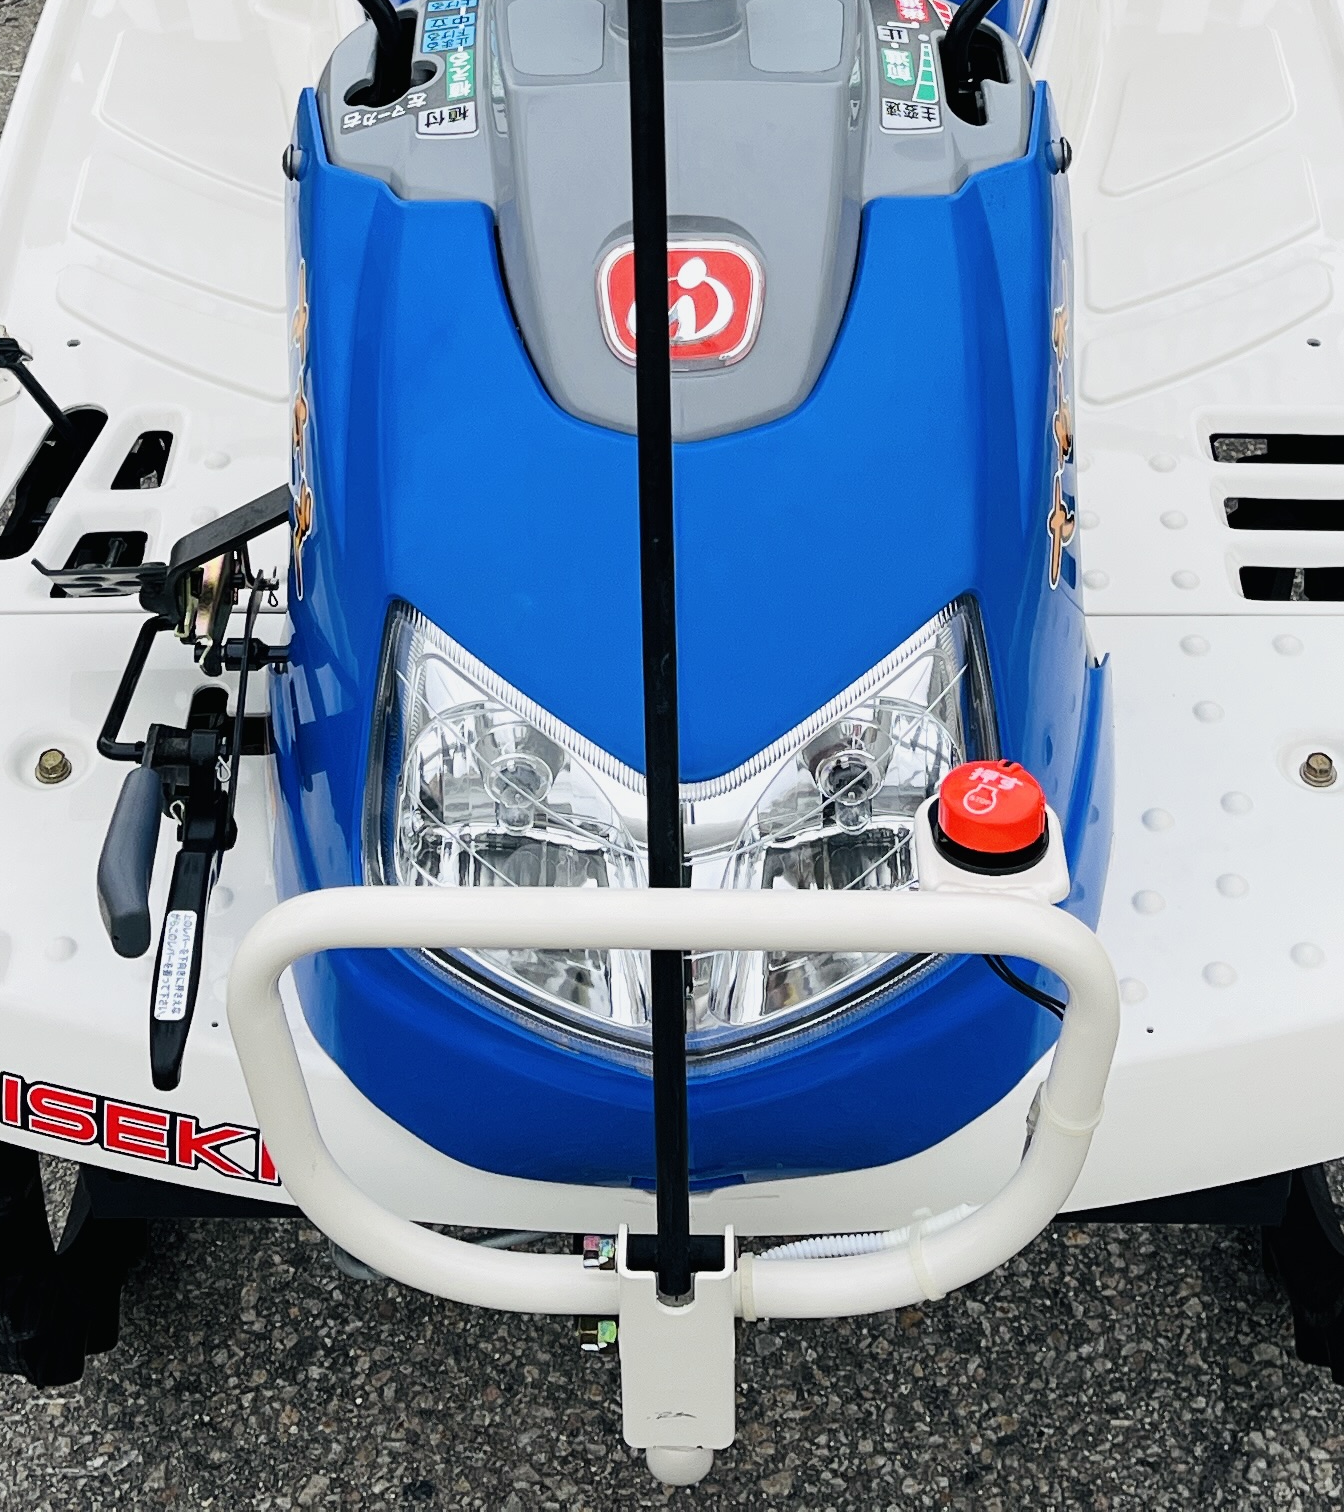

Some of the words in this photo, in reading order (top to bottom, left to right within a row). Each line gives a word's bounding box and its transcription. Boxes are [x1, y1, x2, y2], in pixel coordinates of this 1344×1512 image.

[430, 0, 475, 10] 上げる
[429, 15, 470, 28] 中立
[878, 28, 904, 41] 止
[448, 51, 472, 98] 植える
[424, 105, 470, 128] 植付
[884, 100, 938, 123] 主変速
[968, 766, 1024, 791] 押す
